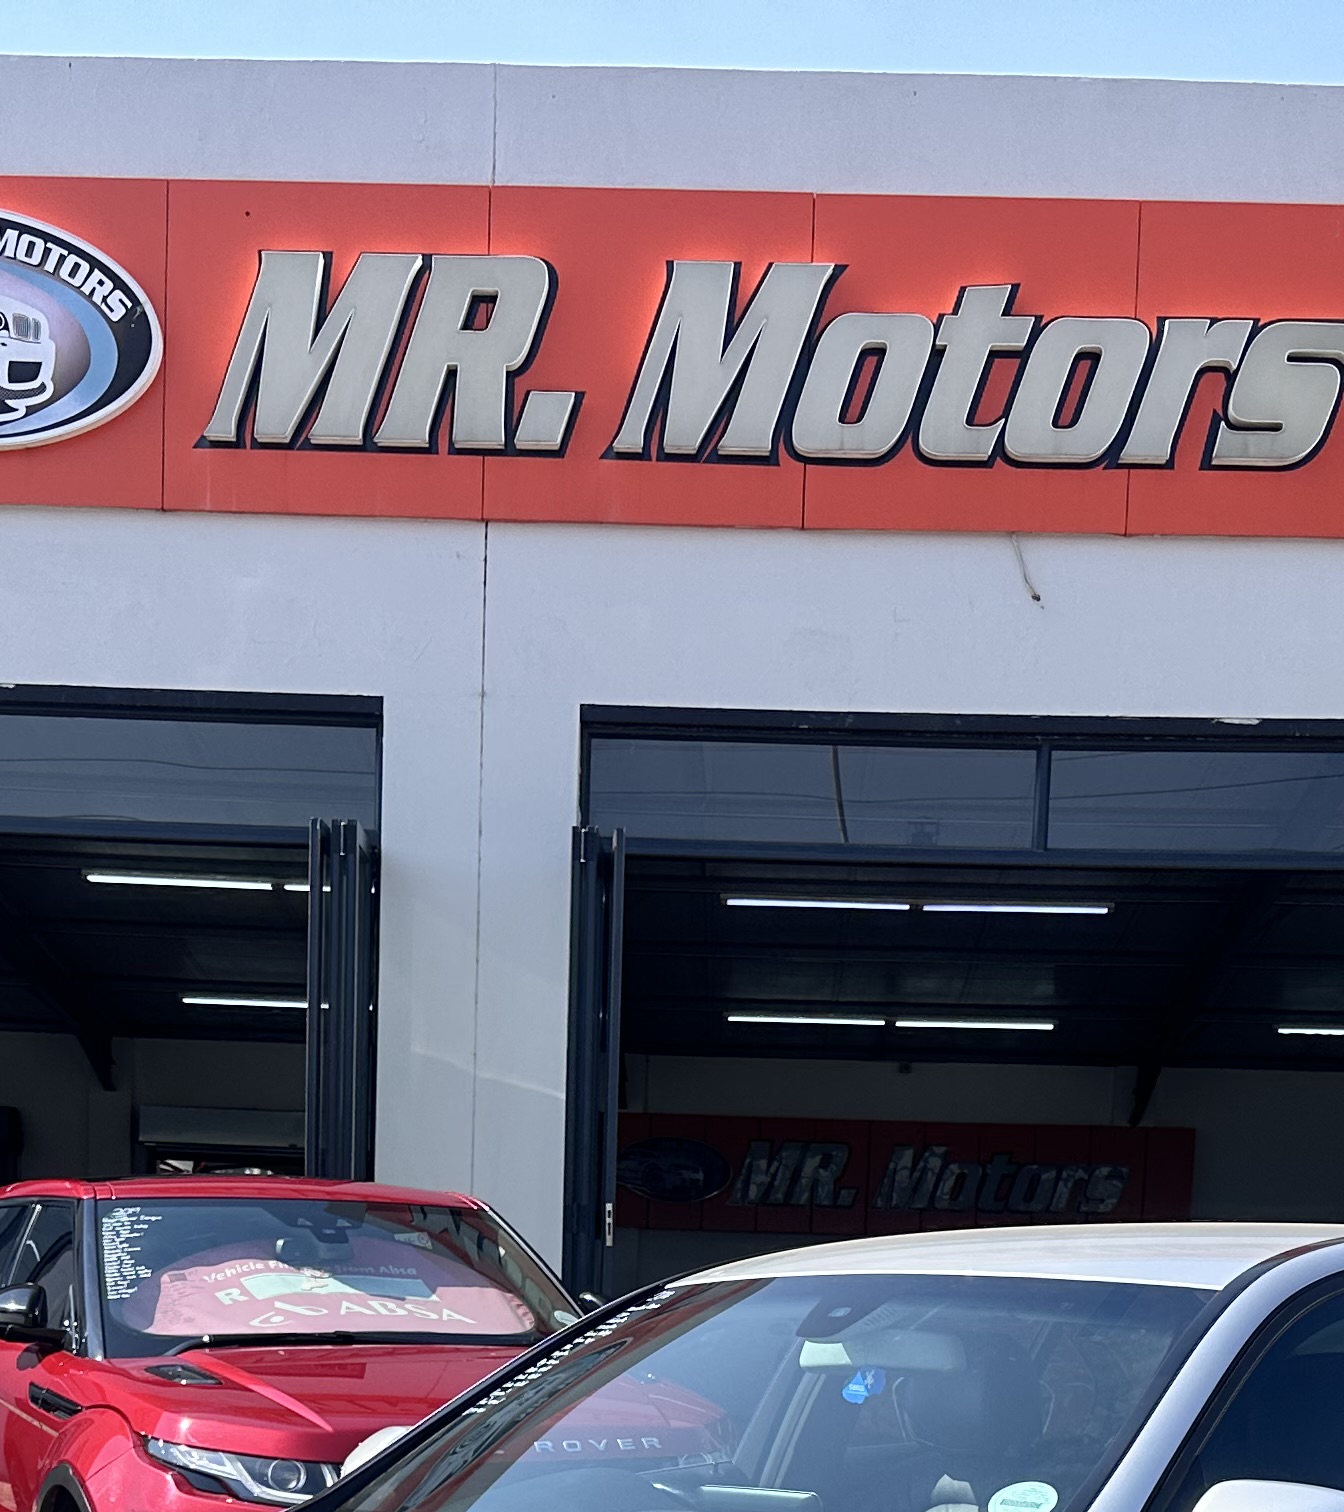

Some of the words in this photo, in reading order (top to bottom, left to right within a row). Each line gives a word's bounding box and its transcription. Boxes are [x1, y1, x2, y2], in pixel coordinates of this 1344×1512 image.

[196, 250, 584, 456] MR.
[726, 1140, 858, 1209] MR.
[871, 1145, 1131, 1214] Motors
[202, 1261, 265, 1283] Vehicle
[379, 1264, 417, 1275] Absa
[214, 1288, 249, 1305] R
[340, 1300, 478, 1324] ABSA
[533, 1437, 662, 1453] ROVER
